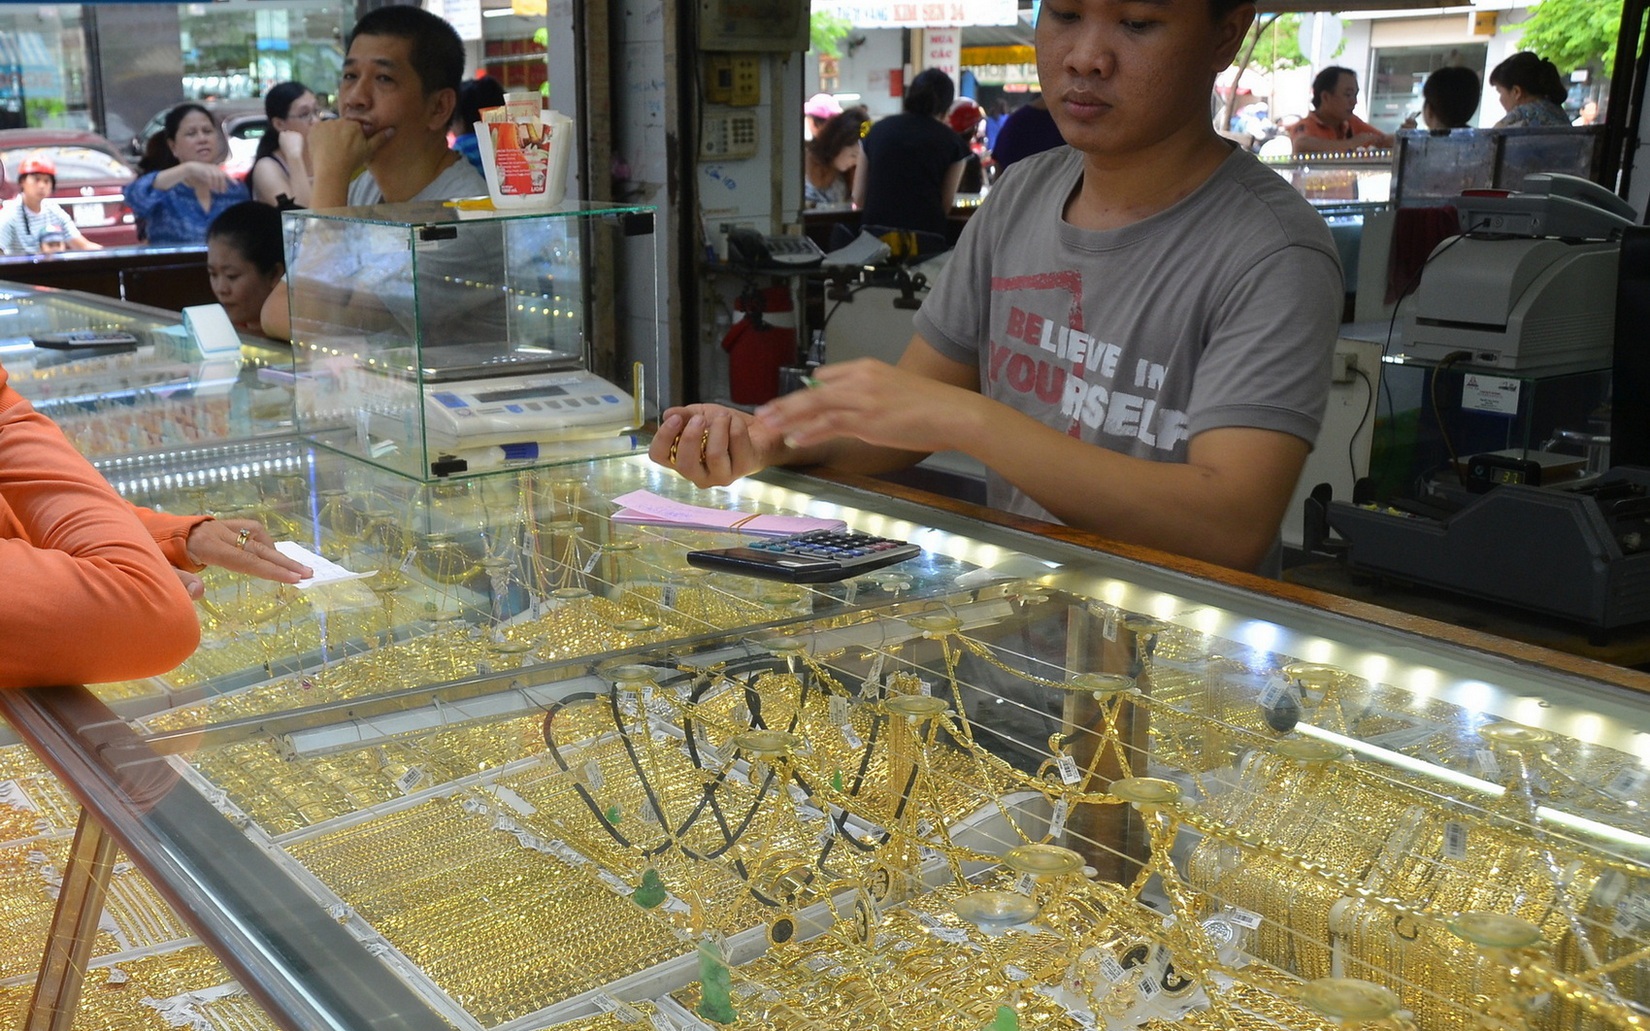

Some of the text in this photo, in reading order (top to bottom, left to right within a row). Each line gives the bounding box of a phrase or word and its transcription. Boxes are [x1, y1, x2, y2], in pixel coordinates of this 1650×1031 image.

[893, 4, 918, 21] KIM
[923, 4, 946, 21] SEN
[1006, 306, 1169, 391] BELIEVE IN
[990, 340, 1189, 450] YOURSELF
